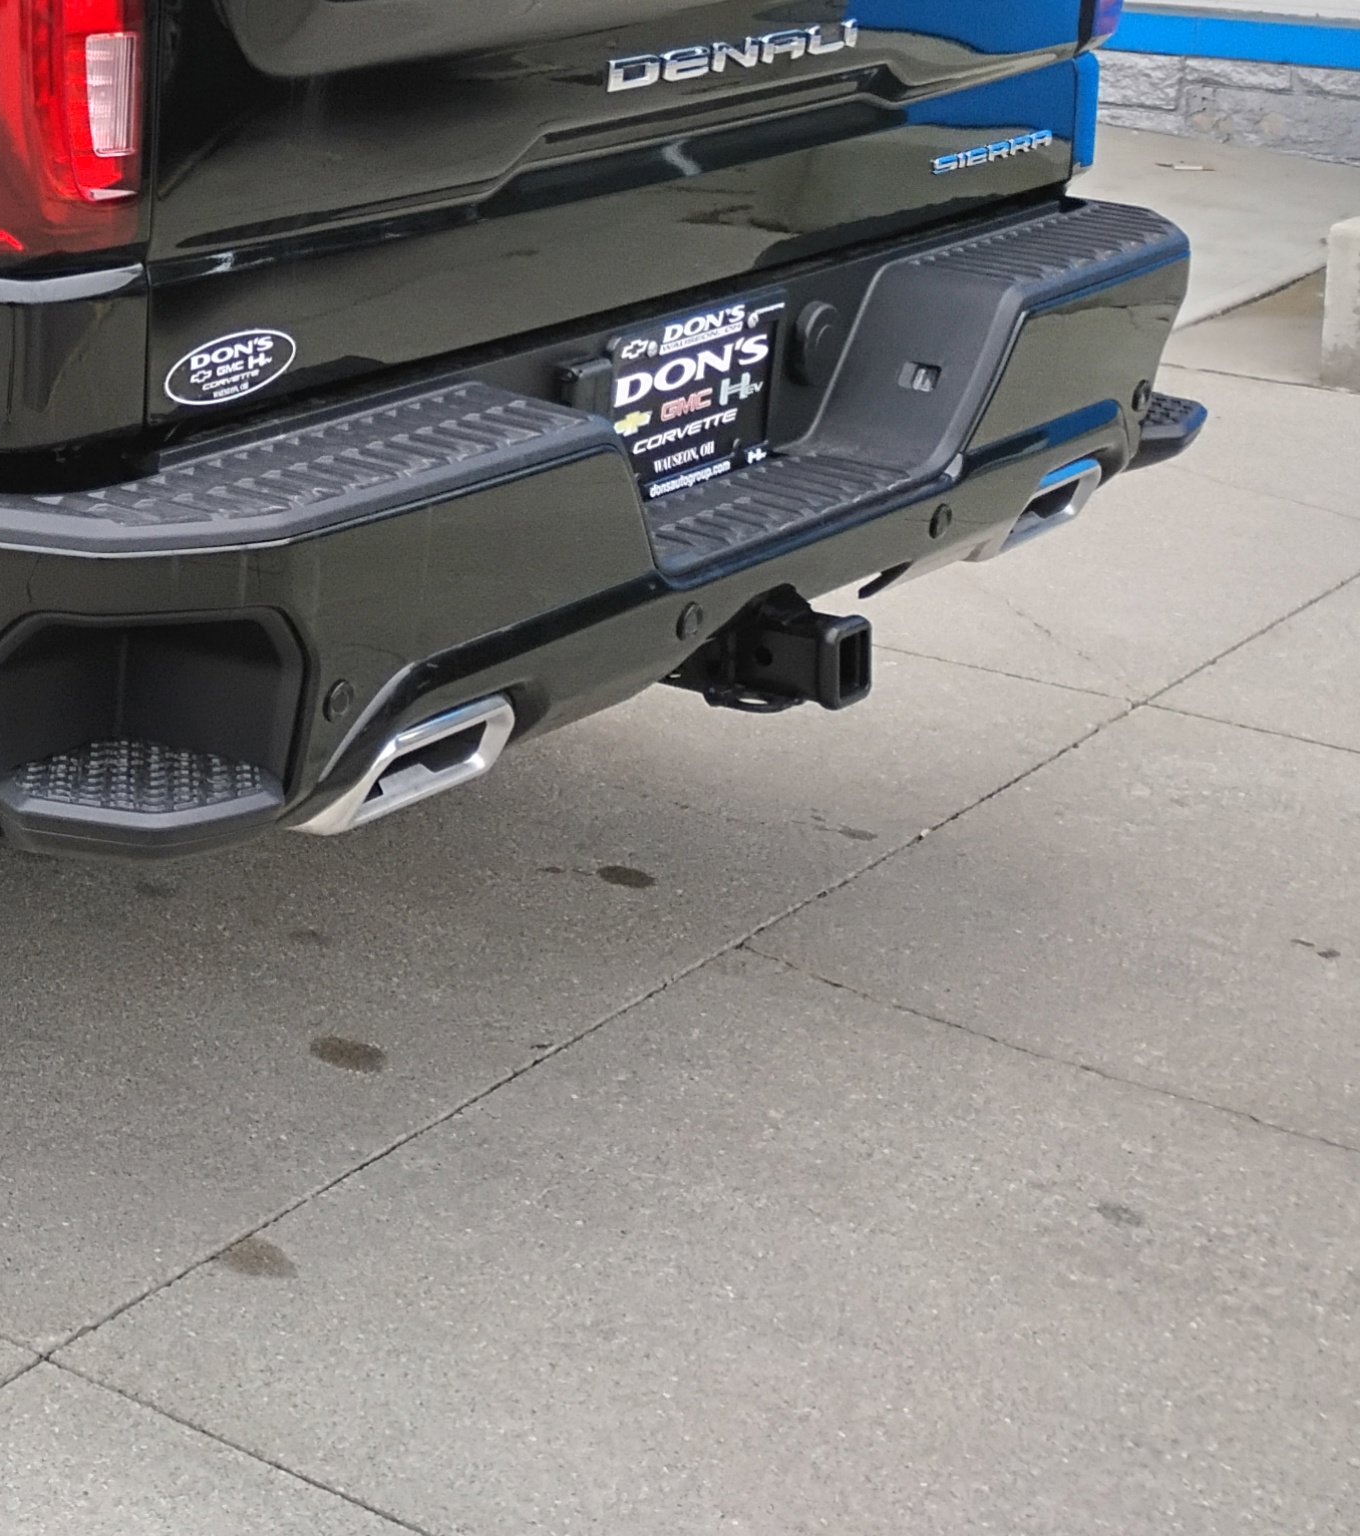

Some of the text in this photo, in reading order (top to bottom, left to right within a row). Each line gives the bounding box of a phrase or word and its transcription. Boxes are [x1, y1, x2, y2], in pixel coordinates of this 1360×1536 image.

[606, 18, 858, 93] DENALI
[930, 129, 1053, 175] SIERRA
[663, 304, 746, 344] DON'S
[190, 336, 274, 371] DON'S
[216, 359, 244, 376] GMC
[614, 333, 769, 408] DON'S
[202, 369, 260, 390] CORVETTE
[660, 388, 713, 422] GMC
[632, 407, 738, 455] CORVETTE
[653, 440, 715, 473] WAUSEON, OH
[649, 461, 732, 498] donsautogroup.com
